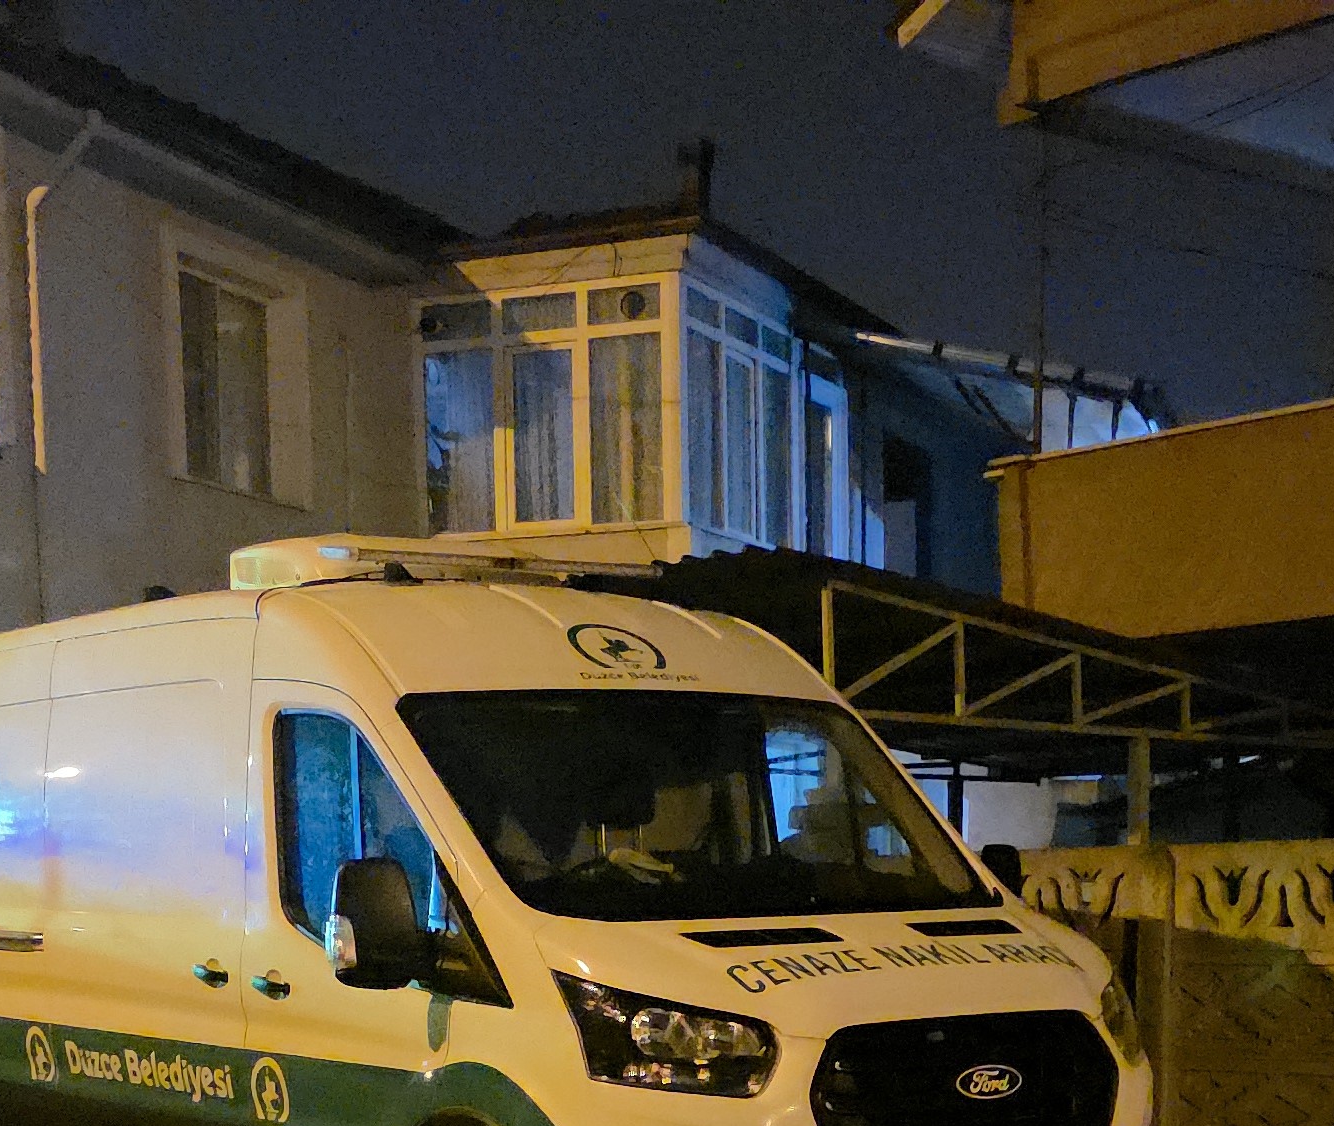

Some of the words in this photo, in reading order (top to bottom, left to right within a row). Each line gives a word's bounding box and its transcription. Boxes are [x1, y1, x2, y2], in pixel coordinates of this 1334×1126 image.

[726, 950, 881, 993] CENAZE
[64, 1040, 124, 1083] Düzce
[124, 1049, 235, 1103] Belediyesi
[969, 1070, 1010, 1094] Ford
